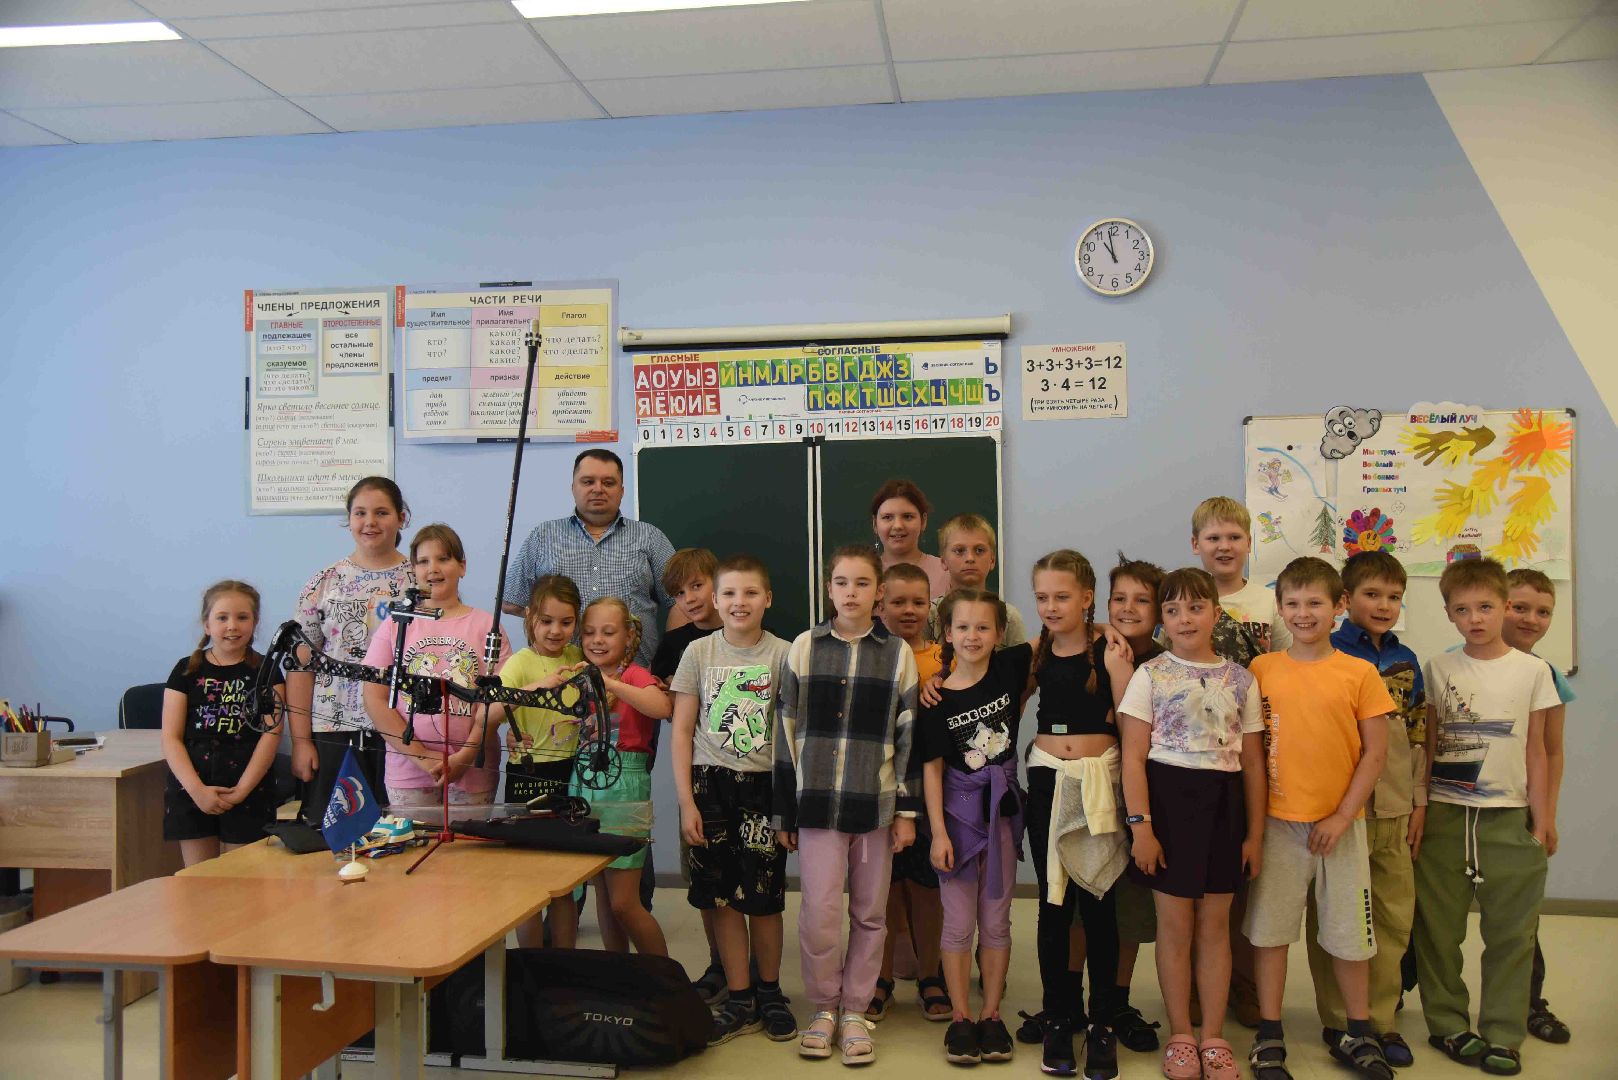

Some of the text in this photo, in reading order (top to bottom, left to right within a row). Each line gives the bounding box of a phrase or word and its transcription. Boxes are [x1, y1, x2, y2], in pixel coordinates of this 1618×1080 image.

[1095, 231, 1102, 240] 11
[1110, 226, 1119, 236] 12
[1125, 230, 1129, 239] 1
[1085, 242, 1095, 252] 10
[1133, 240, 1139, 249] 2
[1083, 254, 1090, 264] 9
[1139, 251, 1144, 260] 3
[1087, 267, 1094, 276] 8
[1135, 263, 1141, 272] 4
[1098, 274, 1104, 284] 7
[1112, 278, 1118, 288] 6
[1126, 273, 1132, 283] 5
[470, 295, 542, 304] ЧАСТИ РЕЧИ
[258, 300, 380, 312] ЧЛЕНЫ ПРЕДЛОЖЕНИЯ
[490, 338, 521, 346] какая?
[565, 335, 601, 344] делать?
[562, 346, 604, 356] сделать?
[818, 346, 880, 356] СОГЛАСНЫЕ
[650, 354, 700, 363] ГЛАСНЫЕ
[985, 357, 998, 375] Ь
[1026, 356, 1122, 372] 3+3+3+3=12
[422, 375, 452, 383] предмет
[1041, 379, 1050, 392] 3
[1061, 378, 1070, 390] 4
[1089, 377, 1106, 390] 12
[985, 384, 1000, 401] Ъ
[257, 403, 278, 413] Ярко
[278, 402, 312, 411] светило
[315, 401, 350, 410] весеннее
[1410, 413, 1477, 423] ВЕСЁЛЫЙ ЛУЧ
[643, 416, 1000, 440] 0 1 2 3 4 5 6 7 8 9 10 11 12 13 14 15 16 17 18 19 20
[258, 438, 286, 448] Сирень
[289, 438, 333, 447] зацветает
[257, 474, 304, 482] Школьники
[307, 473, 330, 482] идут
[416, 636, 466, 650] DESERVE
[204, 678, 245, 694] FIND
[584, 1012, 634, 1026] TOKYO
